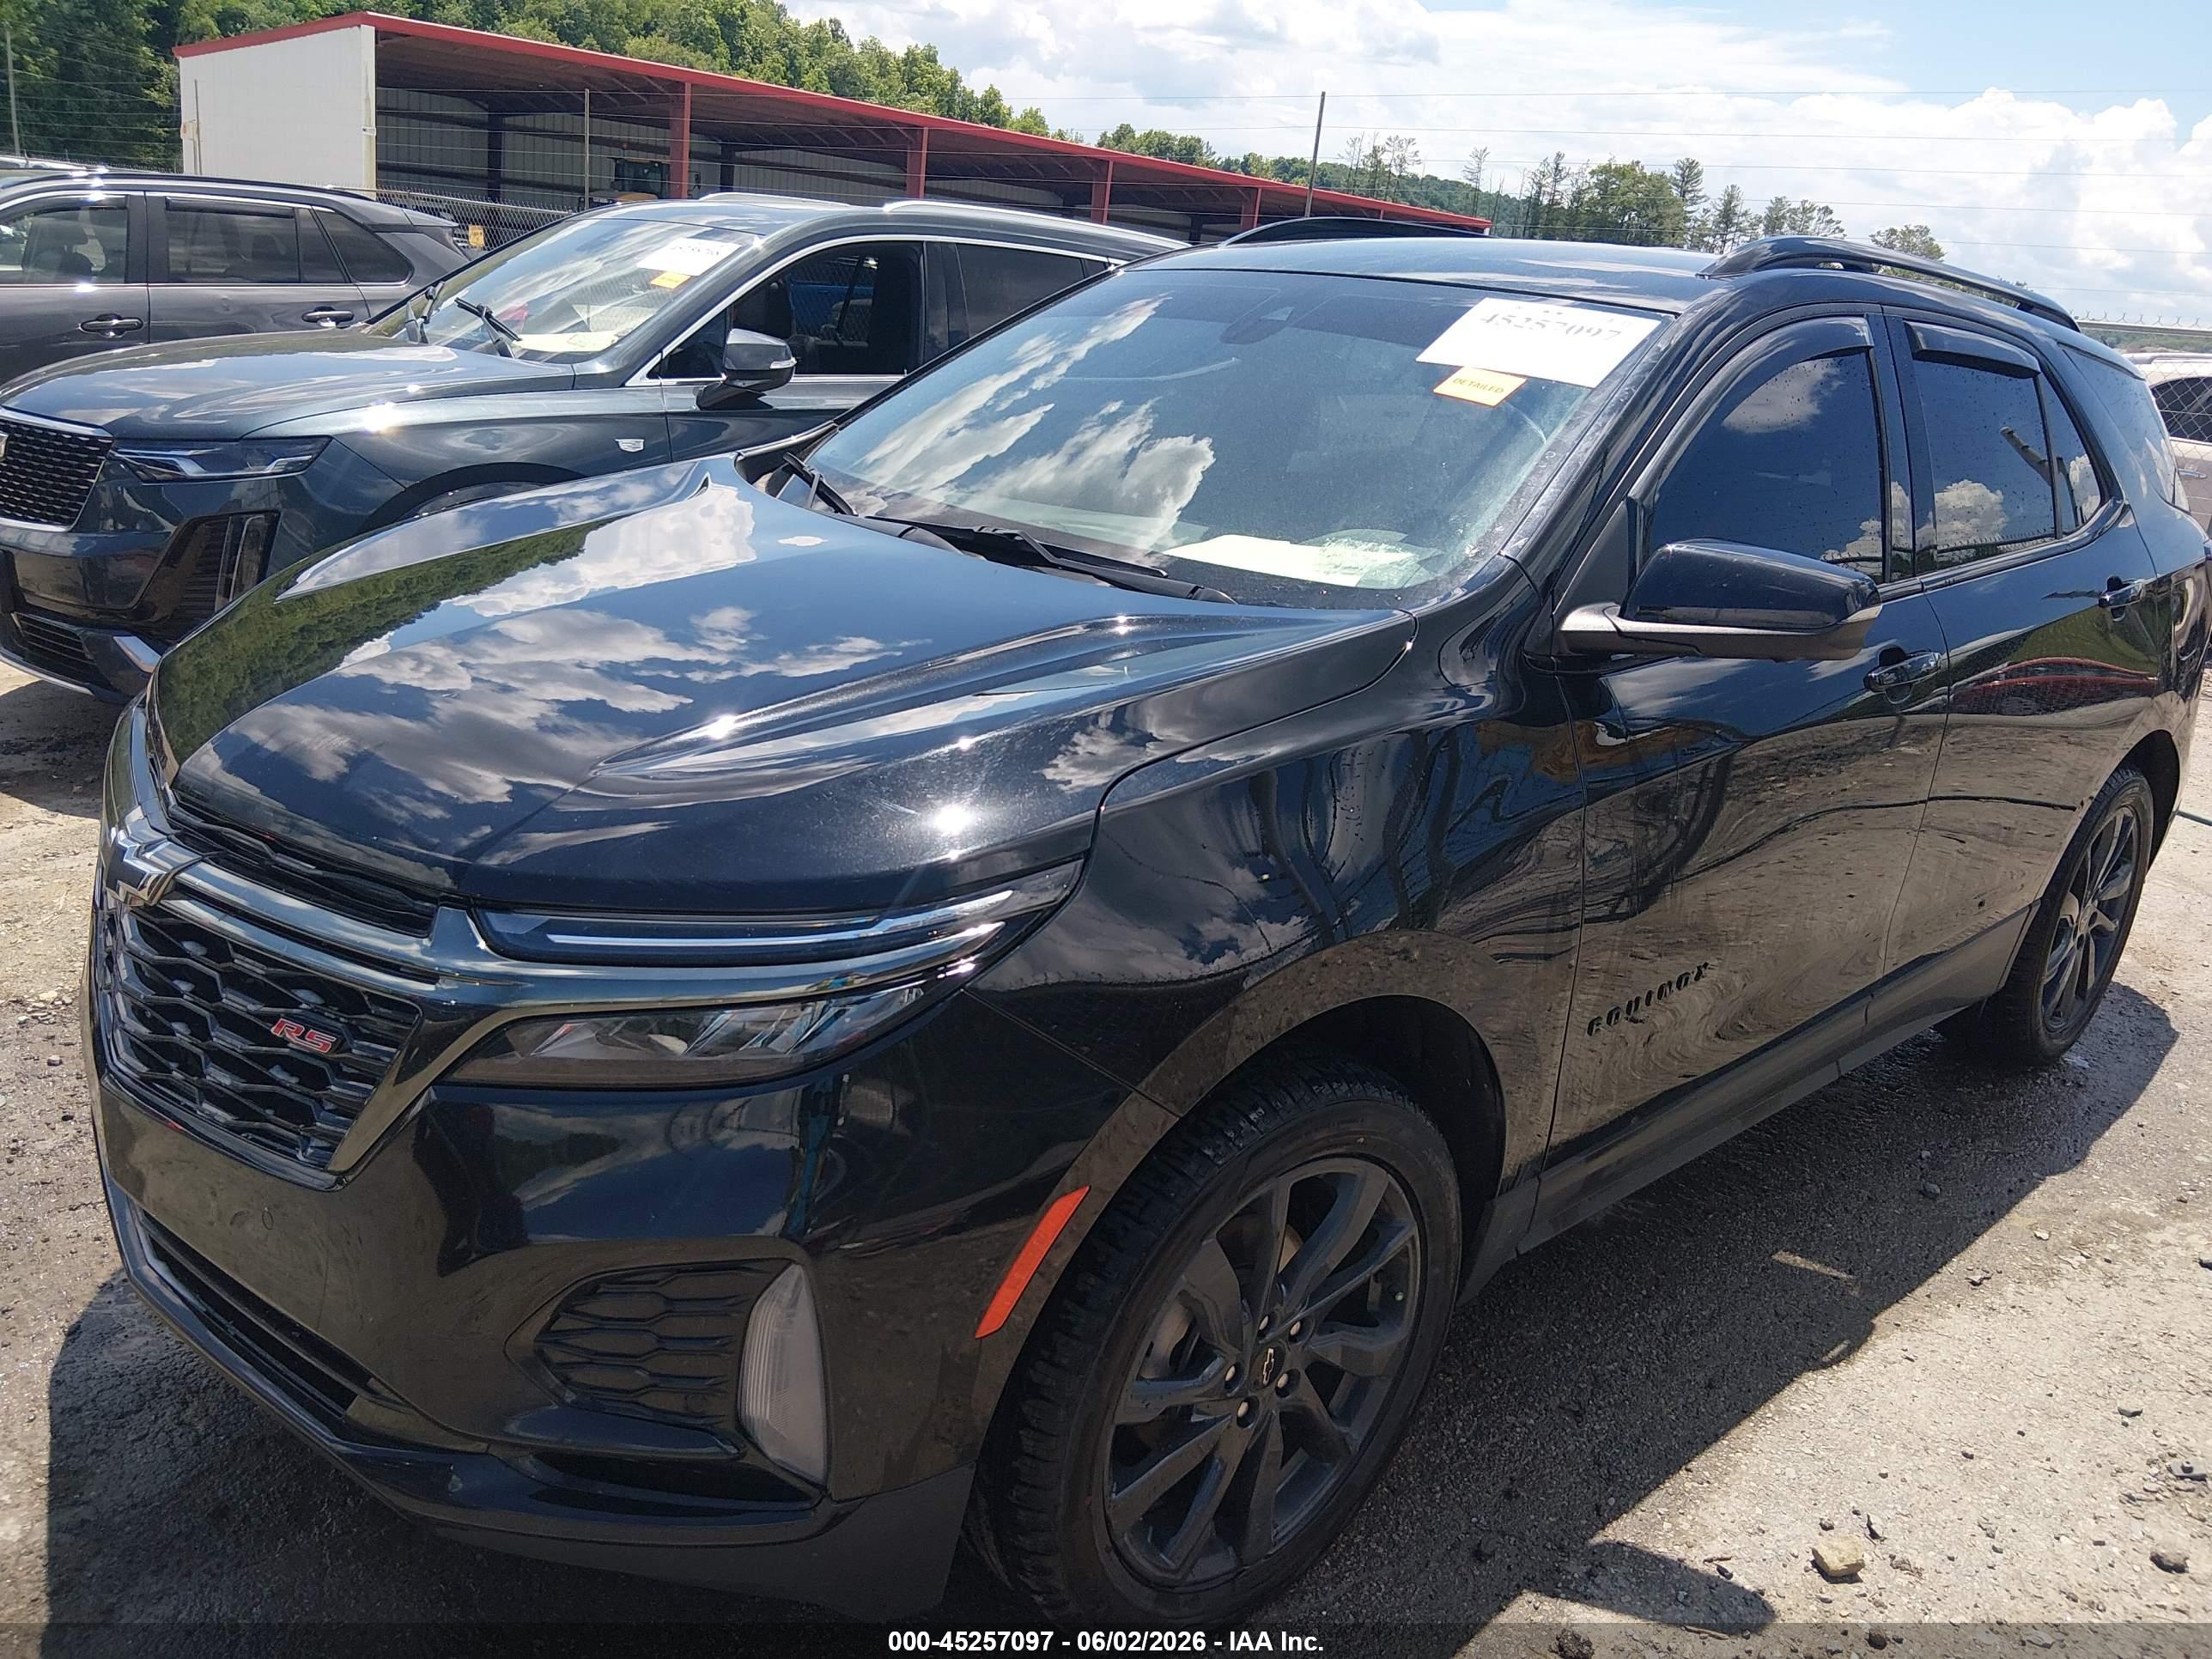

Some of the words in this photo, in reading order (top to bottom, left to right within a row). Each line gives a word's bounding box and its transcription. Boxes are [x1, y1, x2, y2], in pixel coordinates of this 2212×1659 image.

[1480, 311, 1622, 341] 45257097
[1452, 378, 1504, 394] DETAILED
[1586, 961, 1711, 1036] EQUINOX
[270, 1018, 337, 1053] RS
